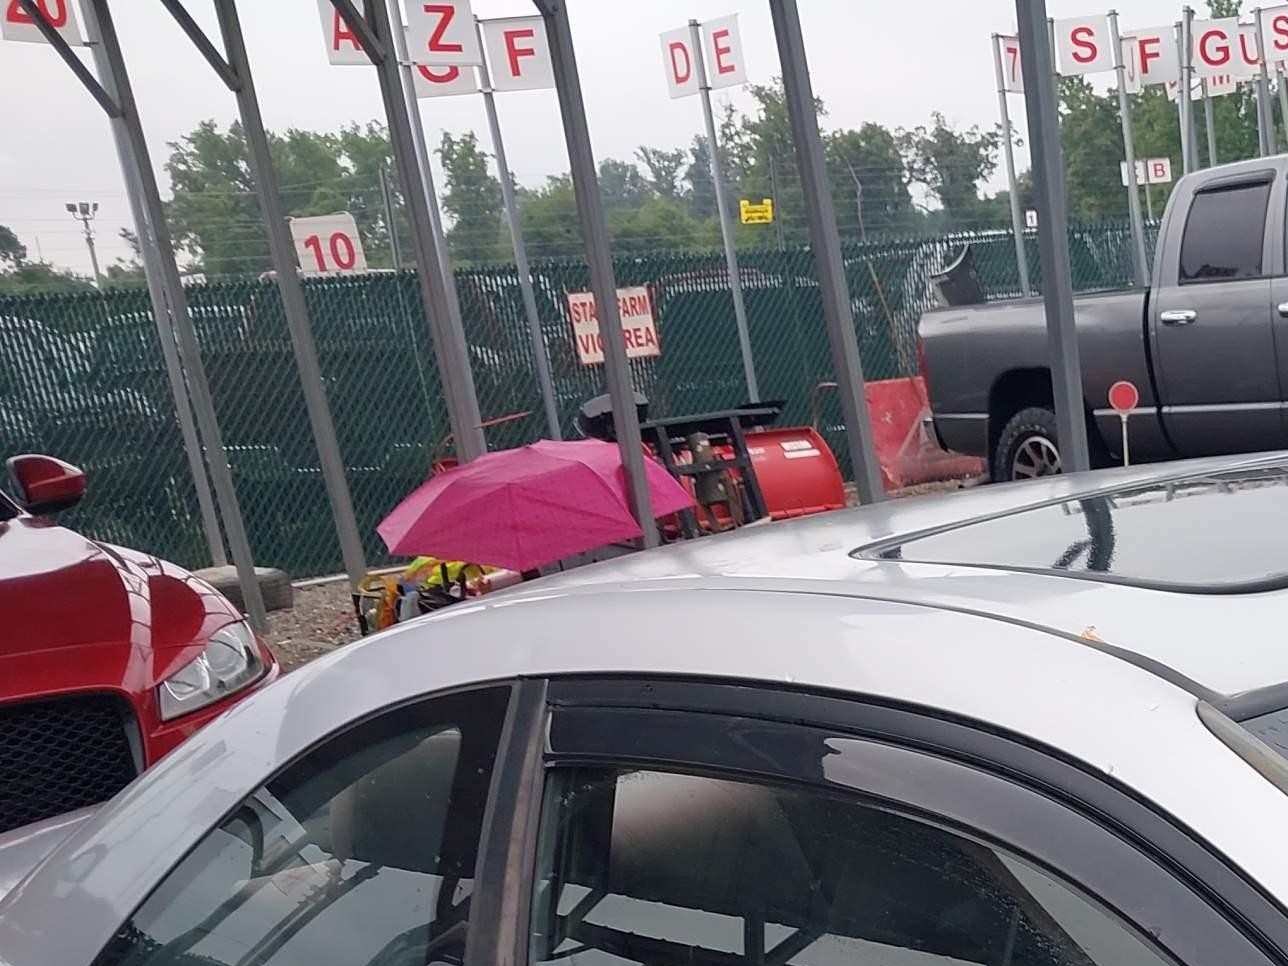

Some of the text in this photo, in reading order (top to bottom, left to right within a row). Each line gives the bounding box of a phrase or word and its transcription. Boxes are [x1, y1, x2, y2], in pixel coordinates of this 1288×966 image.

[423, 4, 464, 53] Z
[1070, 27, 1098, 64] S
[1199, 30, 1231, 66] G
[503, 29, 535, 77] F
[669, 41, 691, 85] D
[712, 29, 735, 74] E
[1138, 37, 1160, 75] F
[1153, 163, 1165, 178] B
[304, 231, 356, 272] 10
